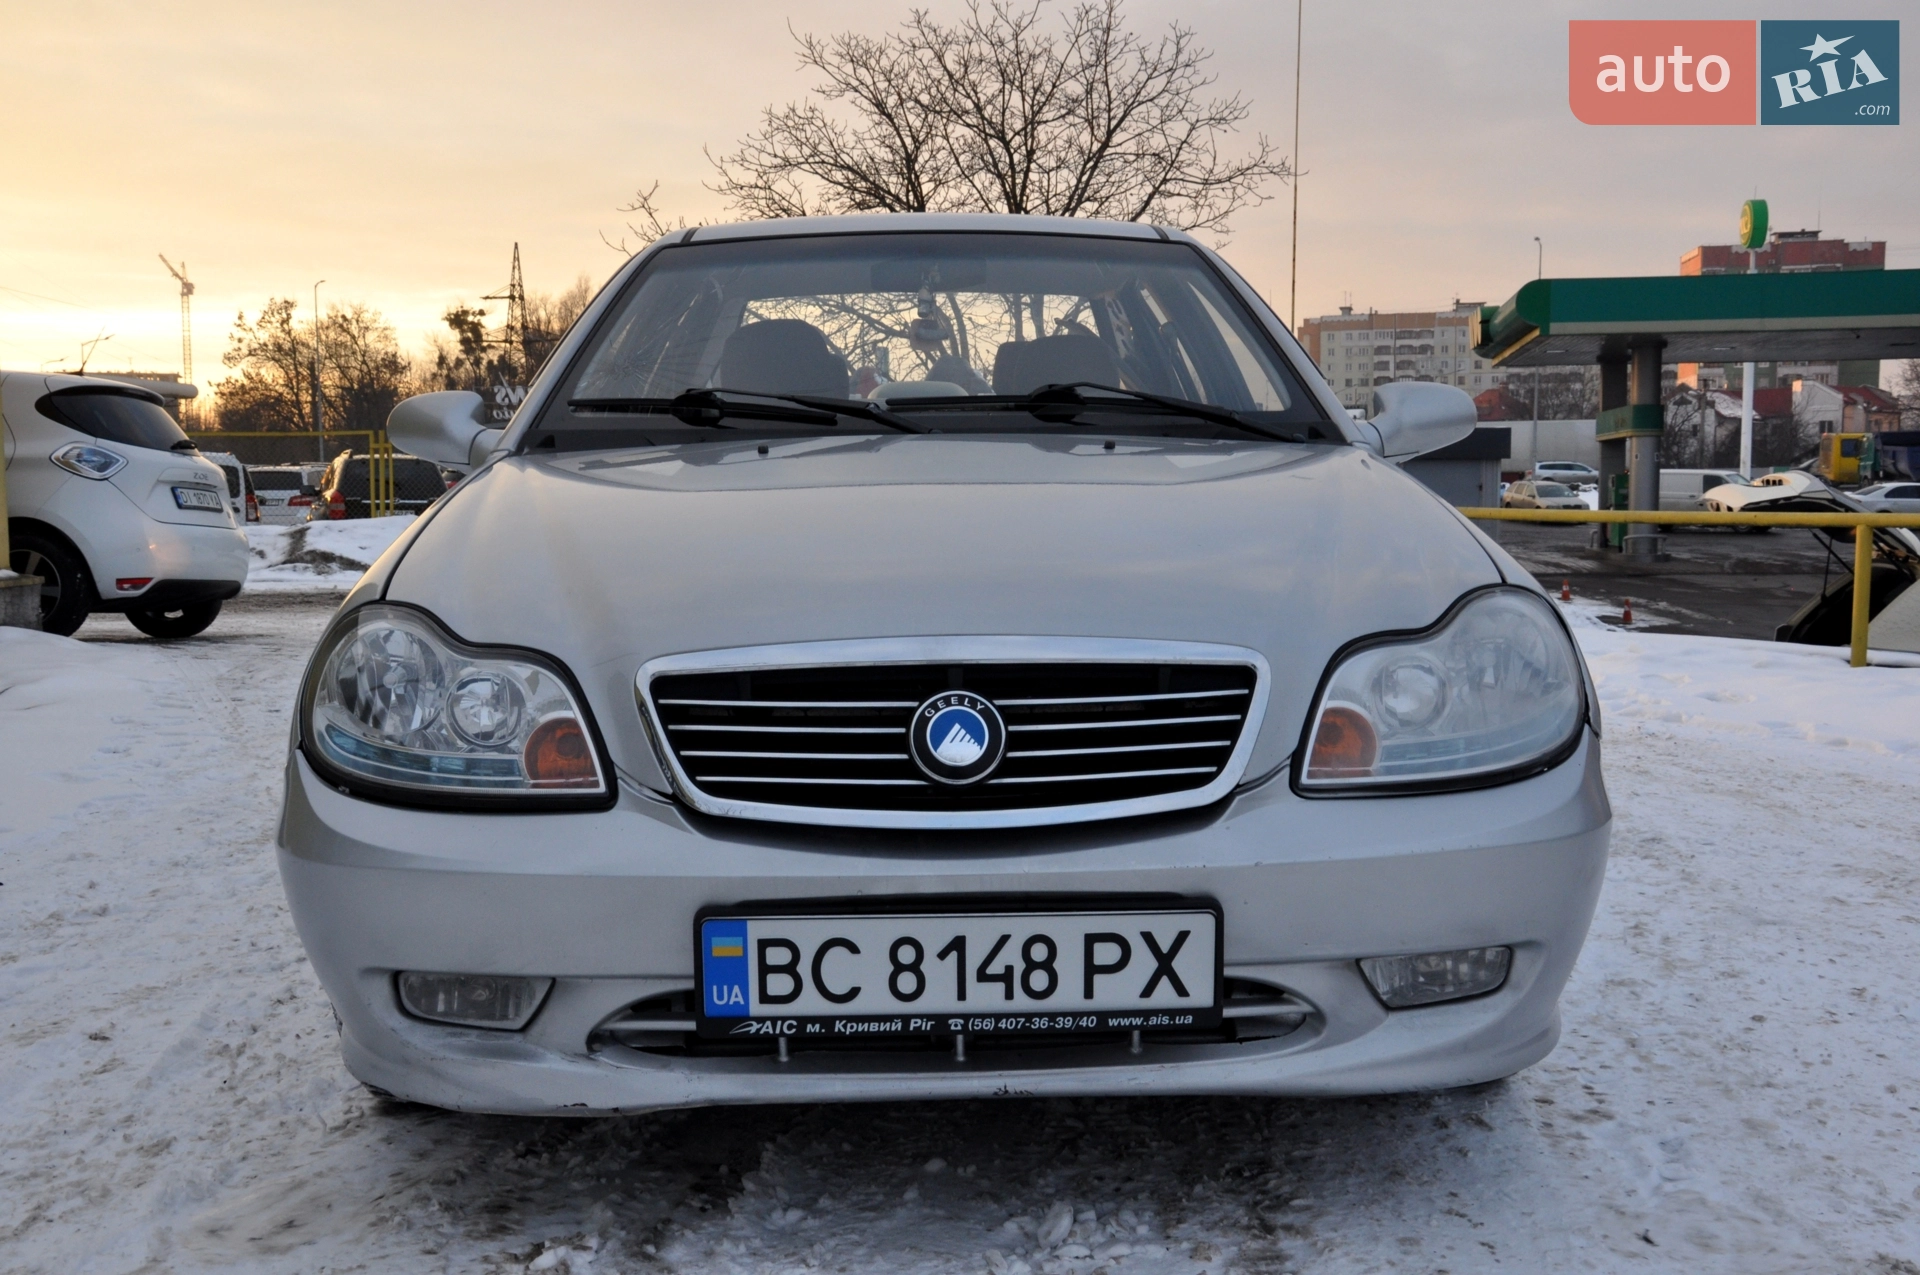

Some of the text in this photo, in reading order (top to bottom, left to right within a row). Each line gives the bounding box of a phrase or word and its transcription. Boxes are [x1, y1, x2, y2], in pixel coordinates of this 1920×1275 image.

[924, 696, 985, 717] GEELY
[757, 930, 1191, 1004] BC 8148 PX
[712, 985, 744, 1005] UA
[834, 1019, 902, 1035] Кривий
[909, 1018, 935, 1031] Ріг
[968, 1017, 995, 1031] (56)
[998, 1016, 1097, 1031] 407-36-39/40
[1108, 1014, 1193, 1027] www.ais.ua
